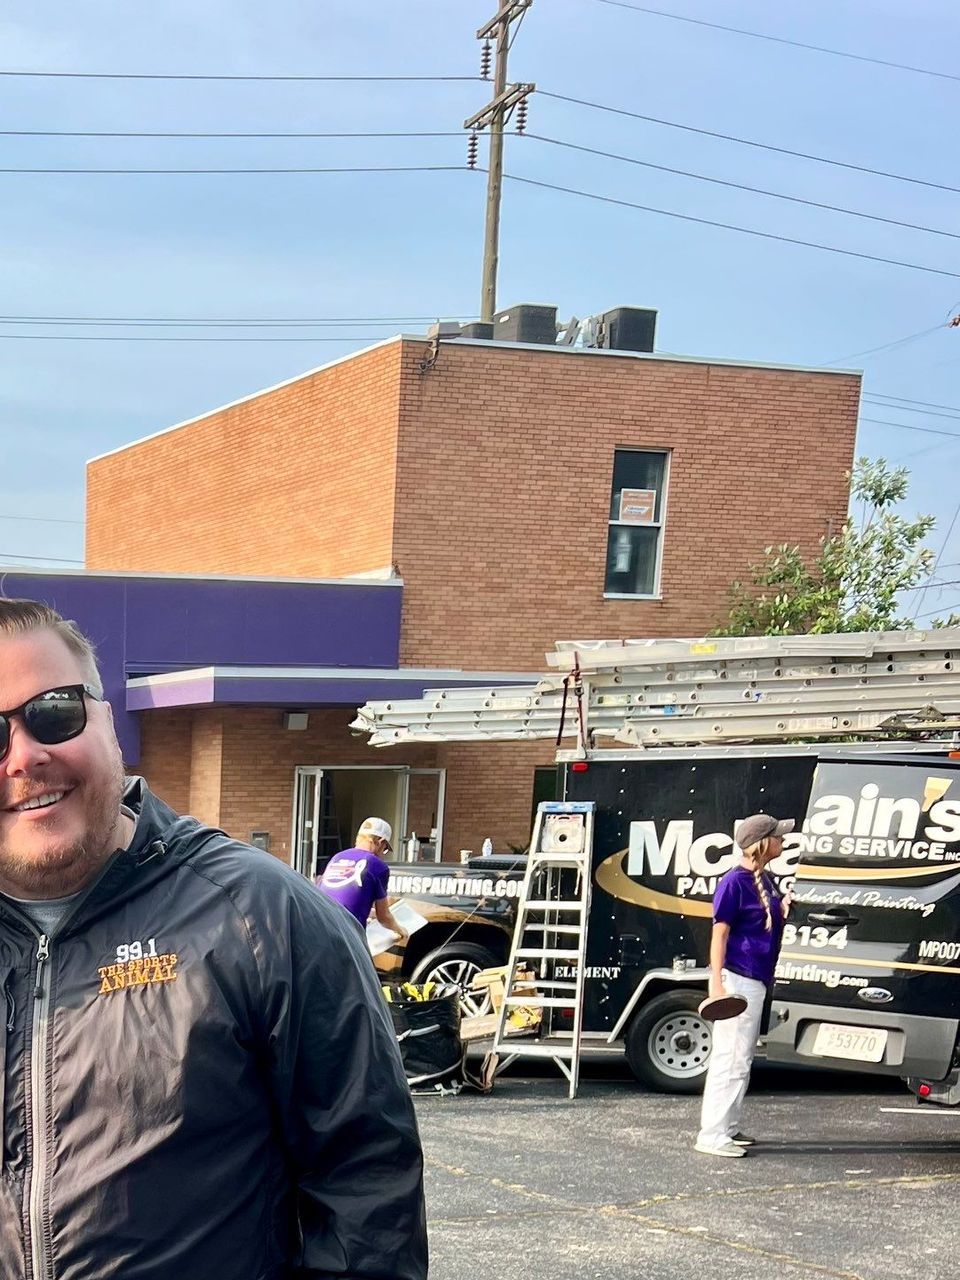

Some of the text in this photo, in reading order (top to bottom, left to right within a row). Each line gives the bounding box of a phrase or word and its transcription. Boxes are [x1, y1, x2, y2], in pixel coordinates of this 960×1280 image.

[839, 837, 946, 861] SERVICE
[863, 890, 937, 918] Painting
[114, 938, 157, 963] 99.1
[98, 953, 178, 978] THE SPORTS
[555, 966, 621, 979] ELEMENT
[98, 964, 177, 994] ANIMAL
